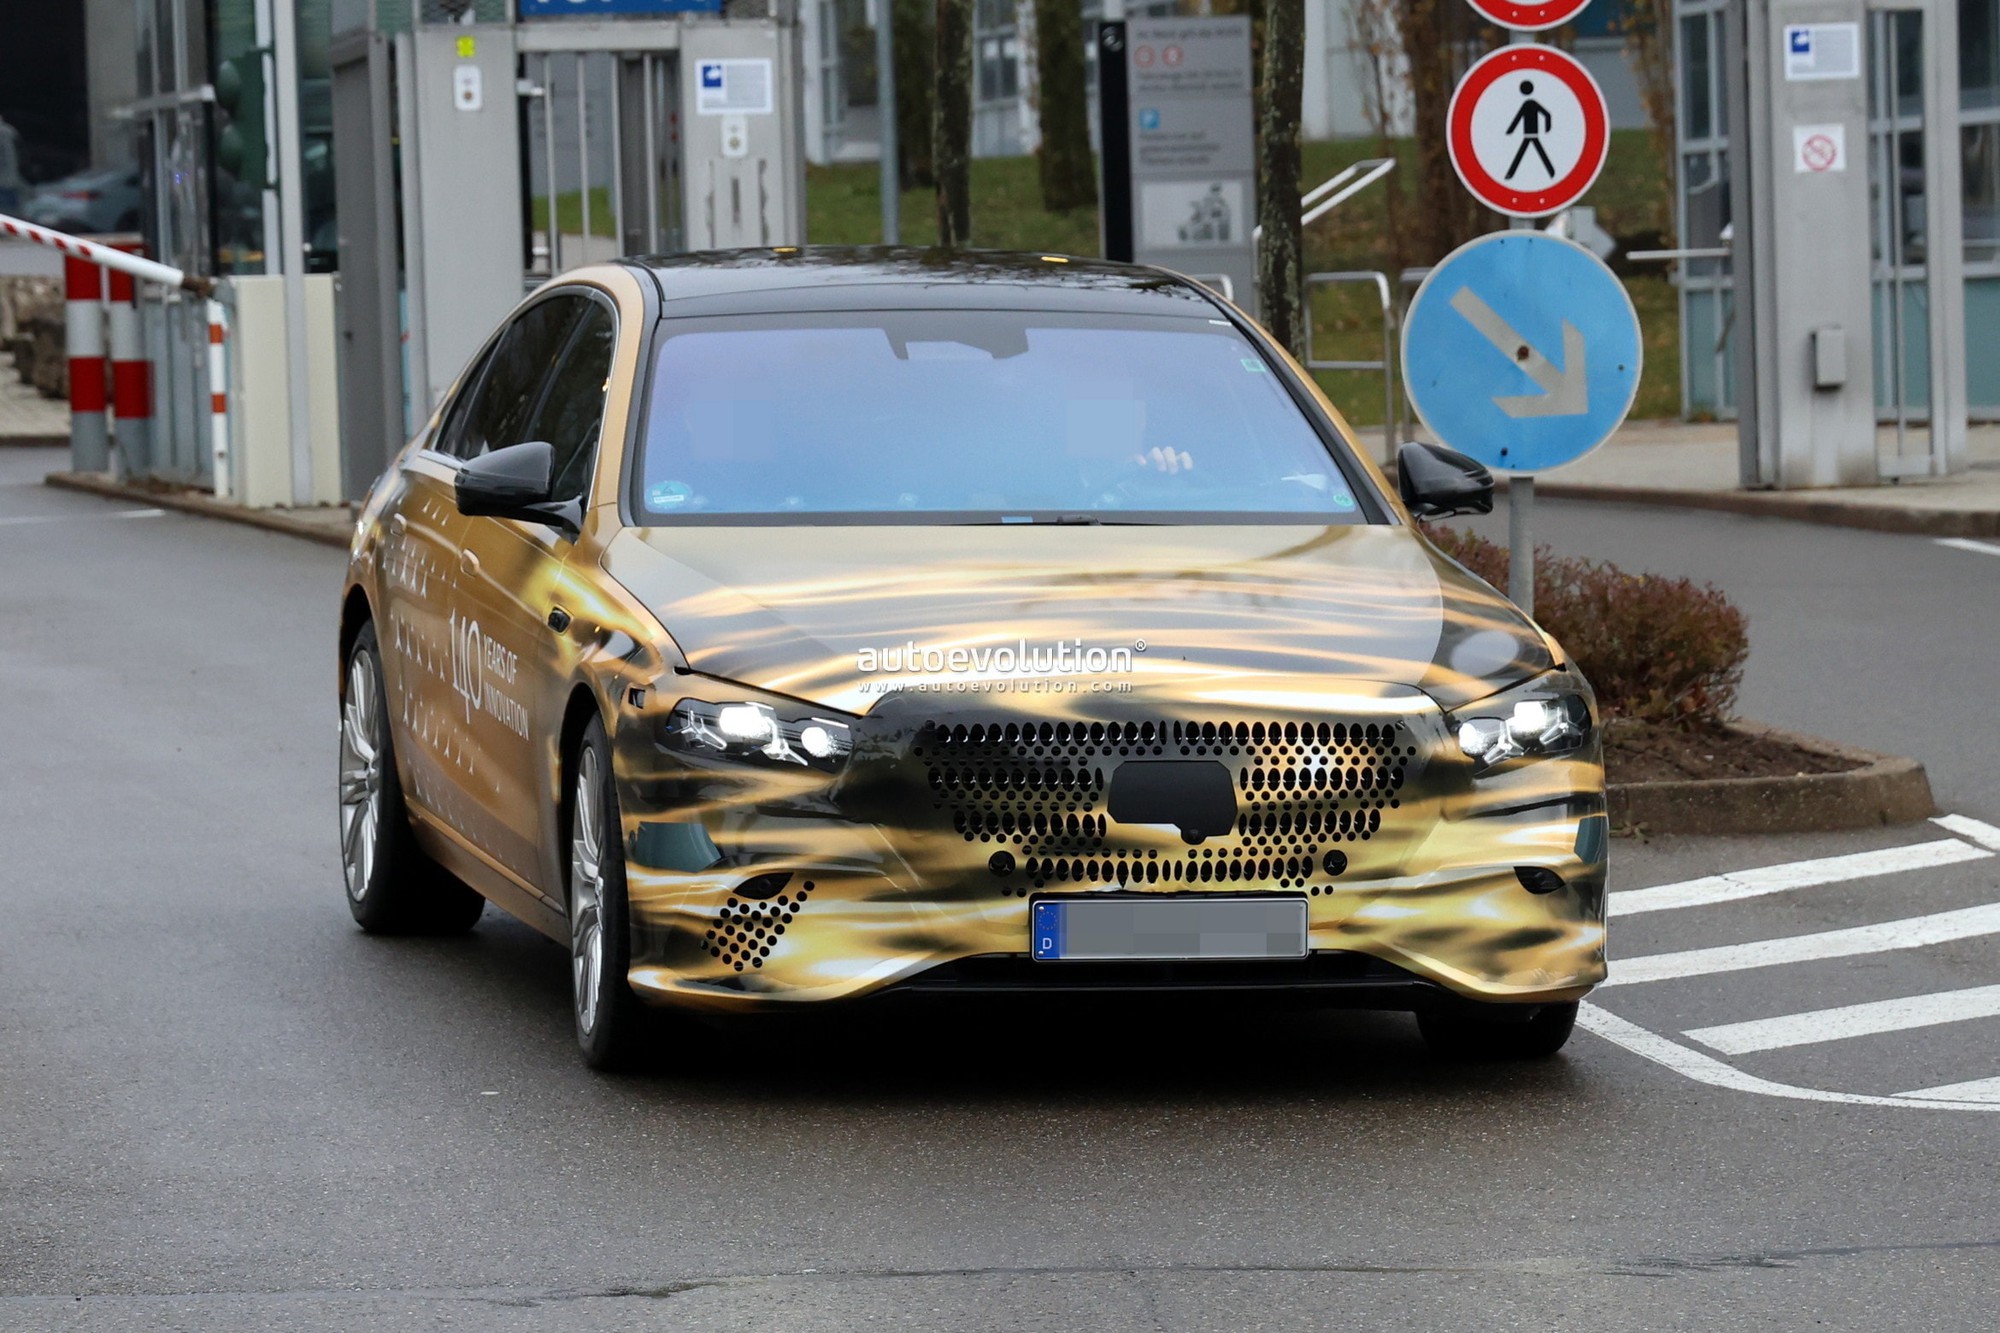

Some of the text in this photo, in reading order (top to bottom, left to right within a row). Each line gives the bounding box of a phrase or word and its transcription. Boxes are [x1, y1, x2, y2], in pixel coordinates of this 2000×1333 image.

[449, 607, 482, 724] 140
[483, 634, 518, 685] YEARS OF
[484, 681, 529, 741] INNOVATION
[1042, 937, 1052, 950] D
